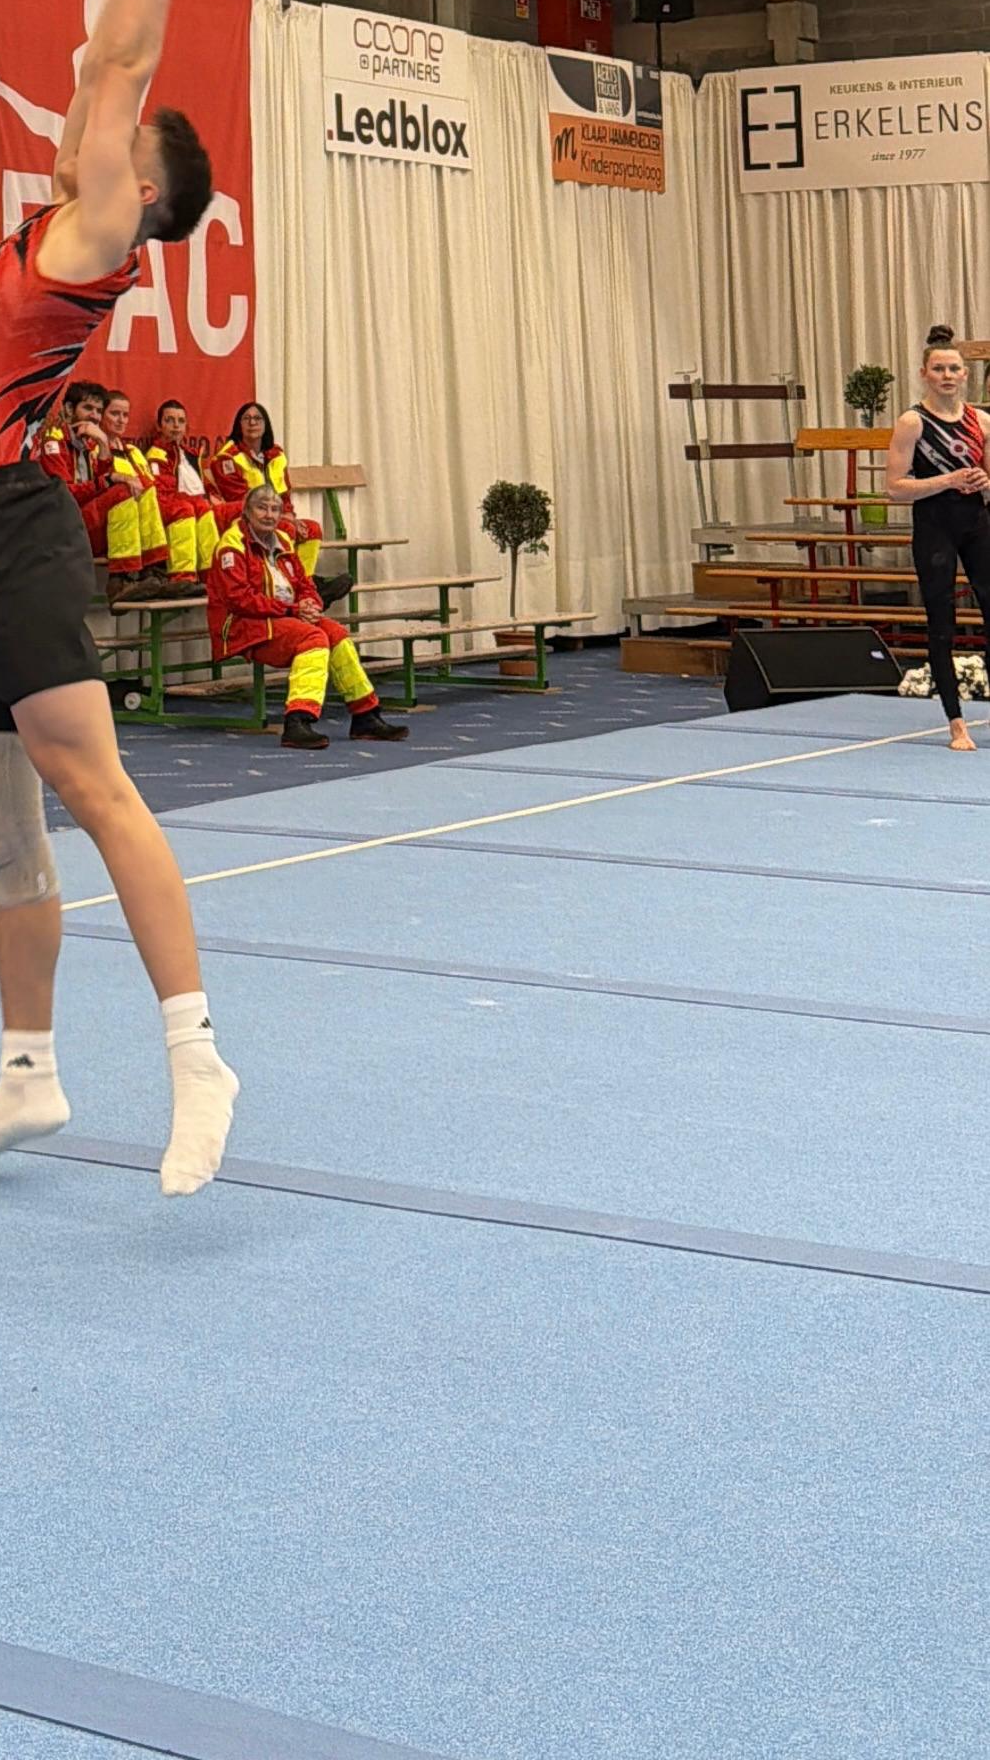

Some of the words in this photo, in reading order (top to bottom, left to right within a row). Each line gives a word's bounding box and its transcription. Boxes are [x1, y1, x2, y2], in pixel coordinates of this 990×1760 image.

[829, 81, 884, 95] KEUKENS
[887, 80, 897, 92] &
[899, 76, 963, 91] INTERIEUR
[814, 100, 983, 140] ERKELENS
[871, 150, 895, 162] since
[899, 149, 926, 161] 1977
